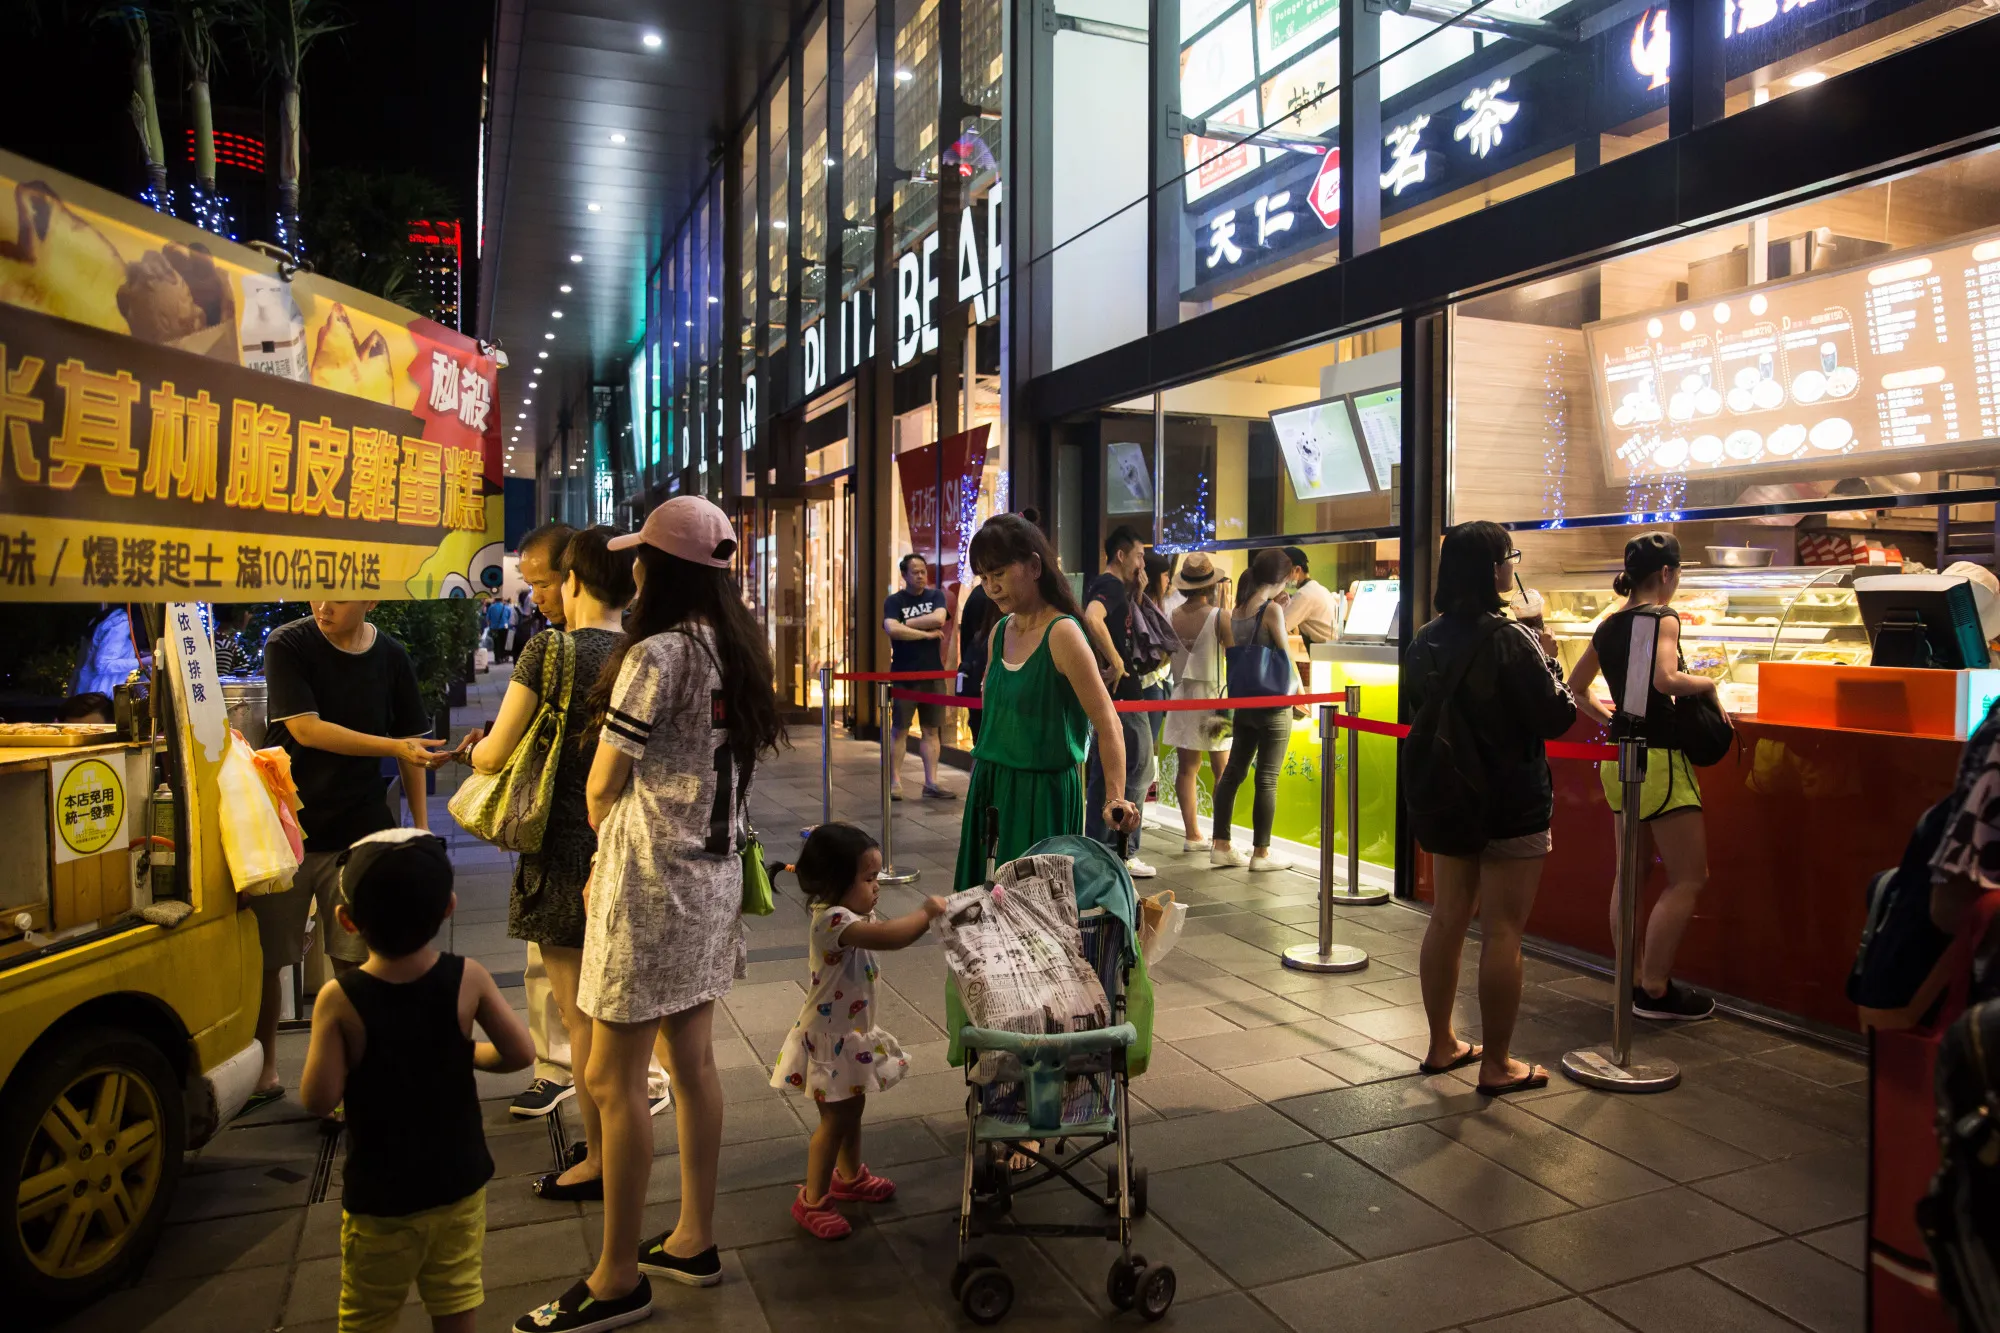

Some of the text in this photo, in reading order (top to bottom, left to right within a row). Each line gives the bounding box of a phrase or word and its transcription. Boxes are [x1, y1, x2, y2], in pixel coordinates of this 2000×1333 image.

[1206, 189, 1295, 269] 天仁
[1380, 78, 1520, 196] 茗茶
[430, 350, 490, 433] 秒殺
[83, 535, 223, 588] 爆漿起士
[235, 544, 381, 591] 滿10份可外送
[901, 602, 934, 619] YALE
[174, 602, 207, 703] 依序排隊
[64, 788, 114, 809] 本店免用
[65, 804, 115, 826] 統一發票
